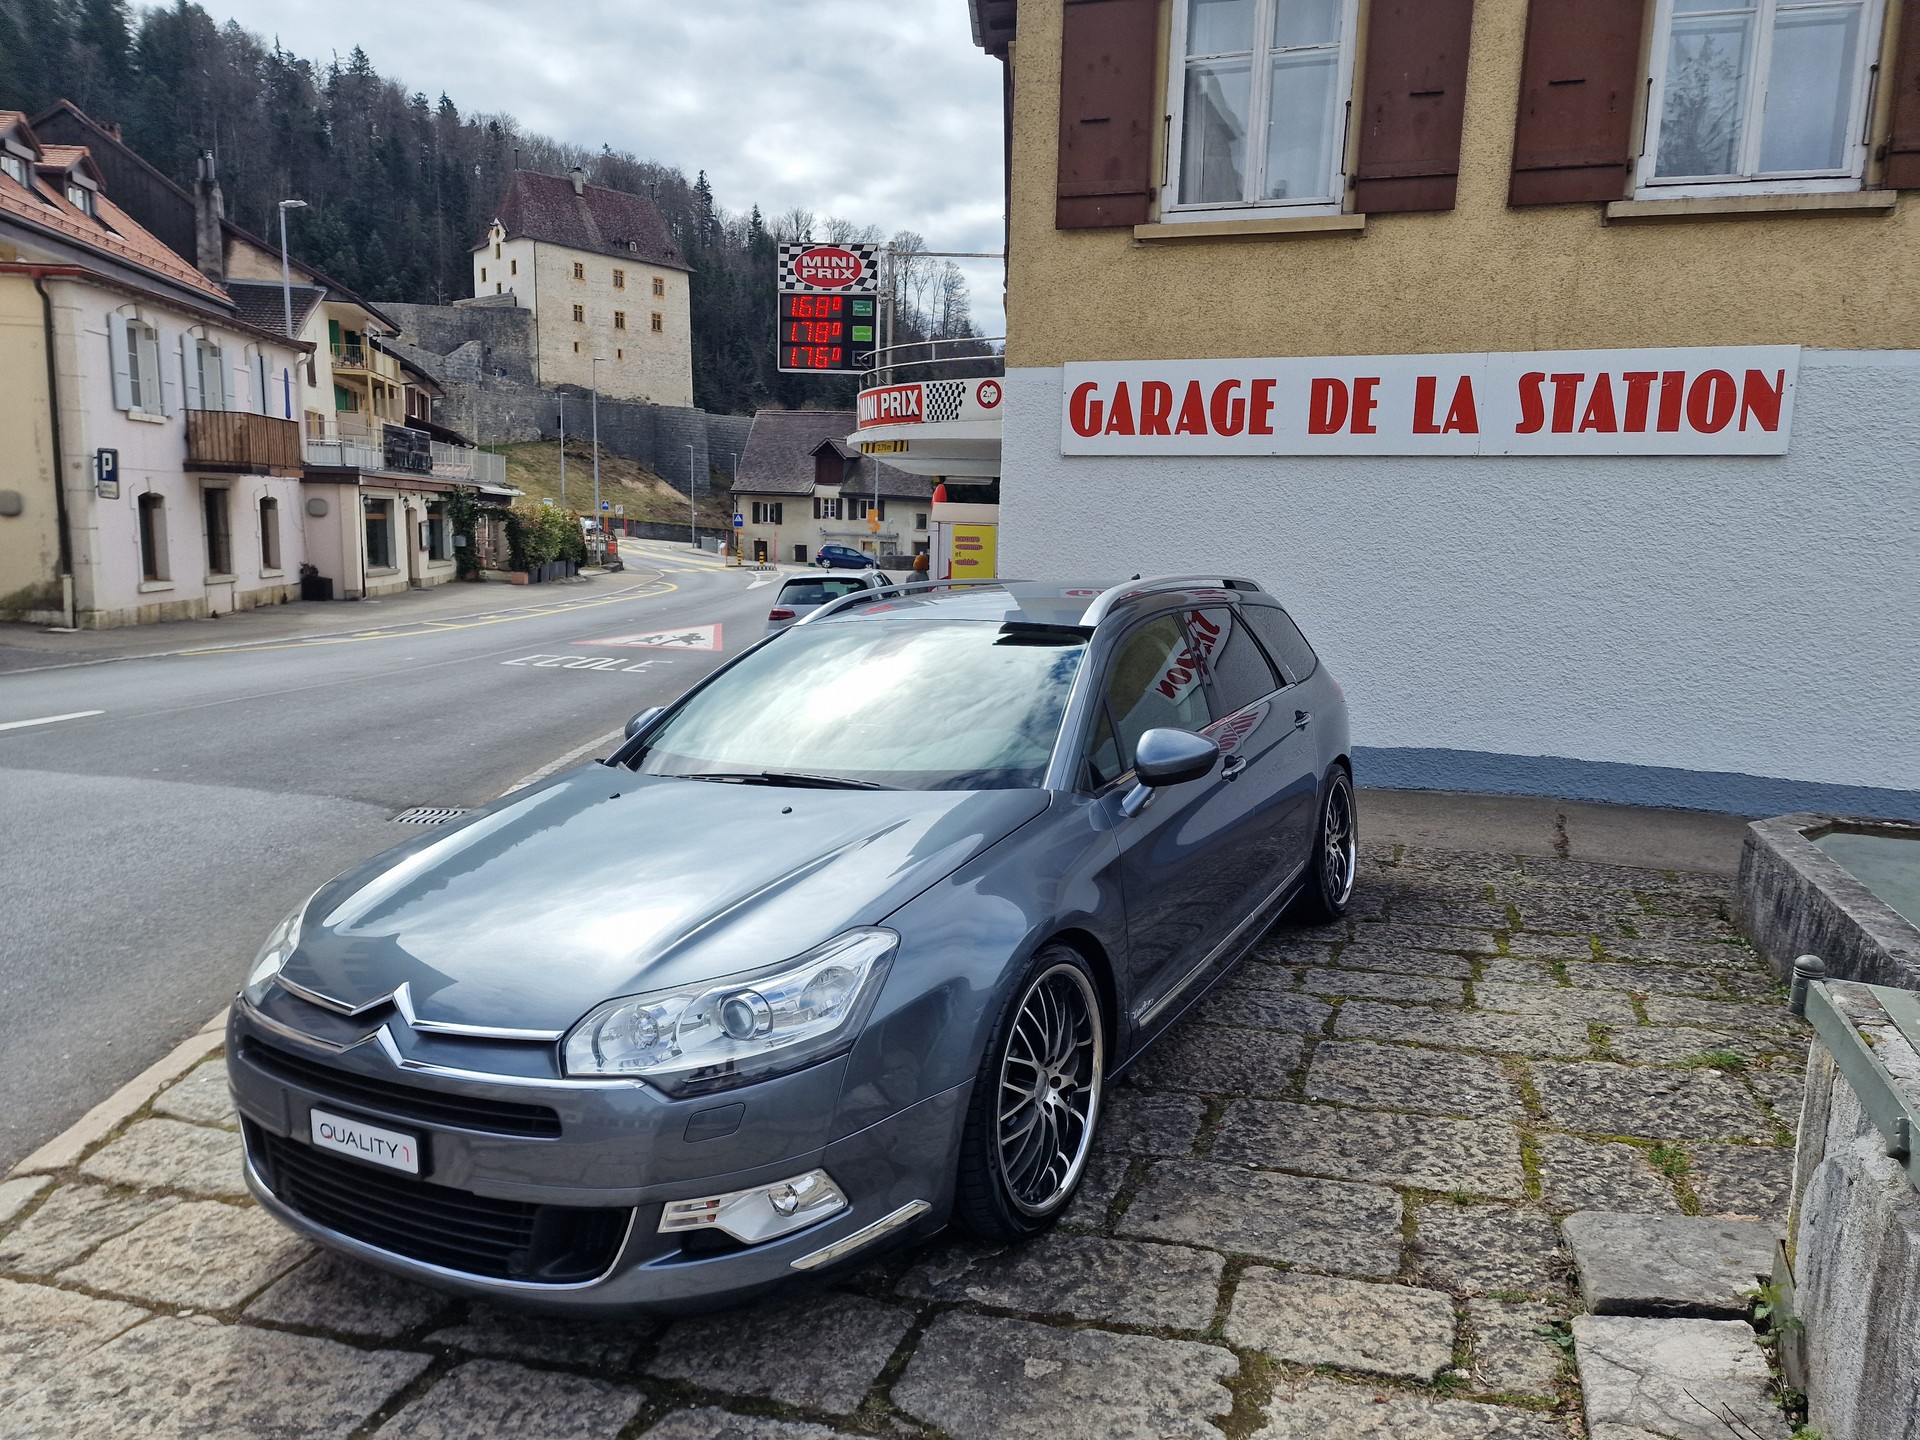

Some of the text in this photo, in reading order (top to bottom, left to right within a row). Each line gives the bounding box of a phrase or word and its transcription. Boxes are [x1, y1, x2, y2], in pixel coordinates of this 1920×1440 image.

[802, 256, 855, 268] MINI
[802, 268, 855, 279] PRIX
[881, 389, 920, 418] PRIX
[1069, 368, 1786, 437] GARAGE DE LA STATION
[101, 452, 113, 479] P
[500, 654, 673, 673] ECOLE
[319, 1123, 398, 1159] QUALITY
